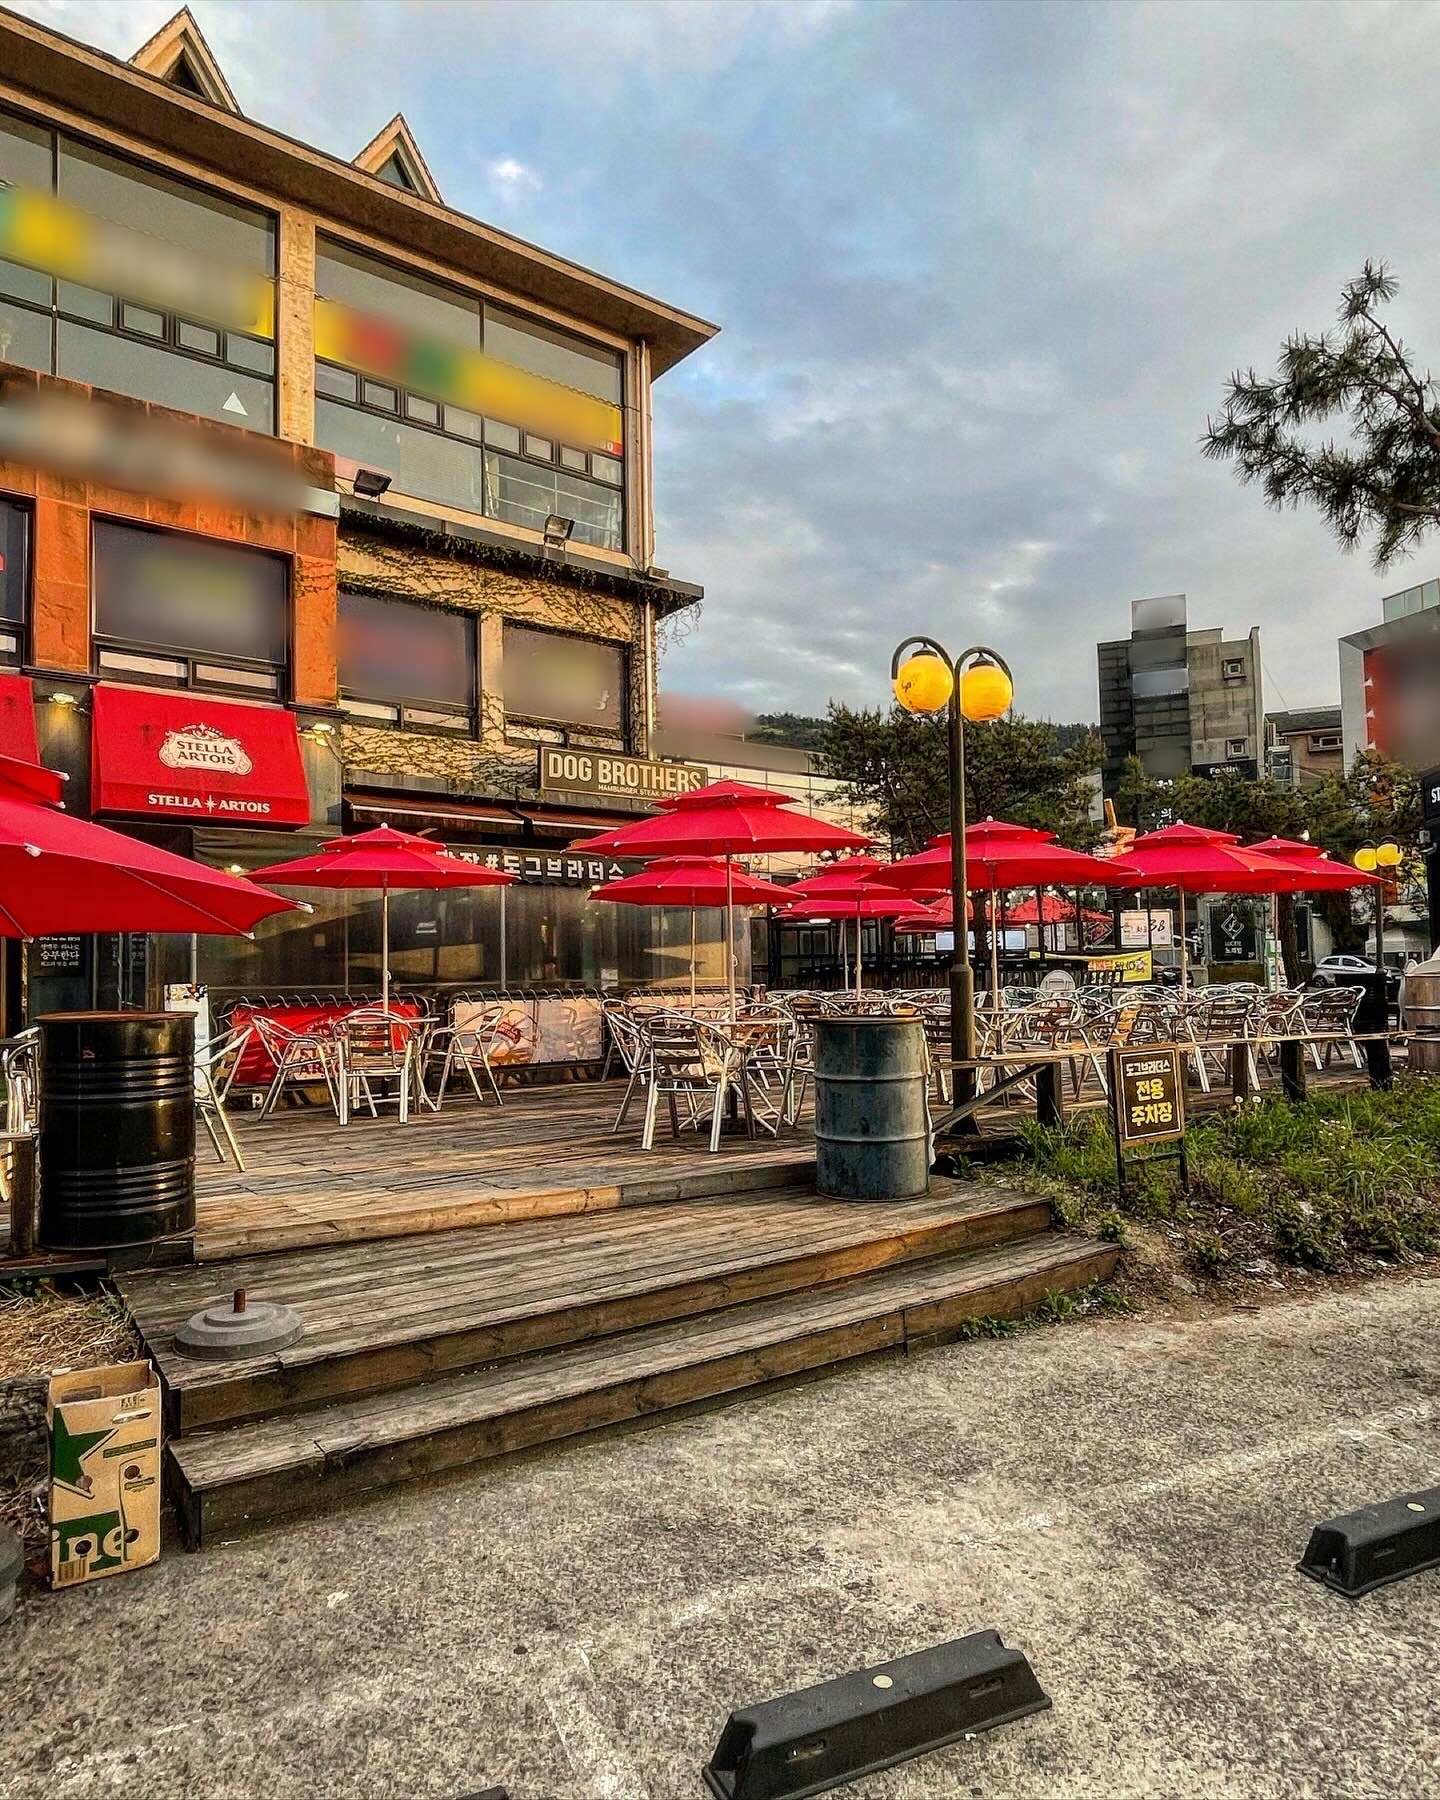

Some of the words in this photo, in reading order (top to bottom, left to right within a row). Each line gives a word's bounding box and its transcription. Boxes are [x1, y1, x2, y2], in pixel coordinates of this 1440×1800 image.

[177, 741, 233, 755] STELLA
[177, 751, 235, 765] ARTOIS
[548, 753, 593, 782] DOG
[598, 759, 701, 793] BROTHERS
[148, 794, 202, 809] STELLA
[218, 800, 270, 814] ARTOIS
[1126, 1059, 1171, 1077] 도그브라더스
[1136, 1078, 1165, 1101] 전용
[1131, 1101, 1173, 1127] 주차장
